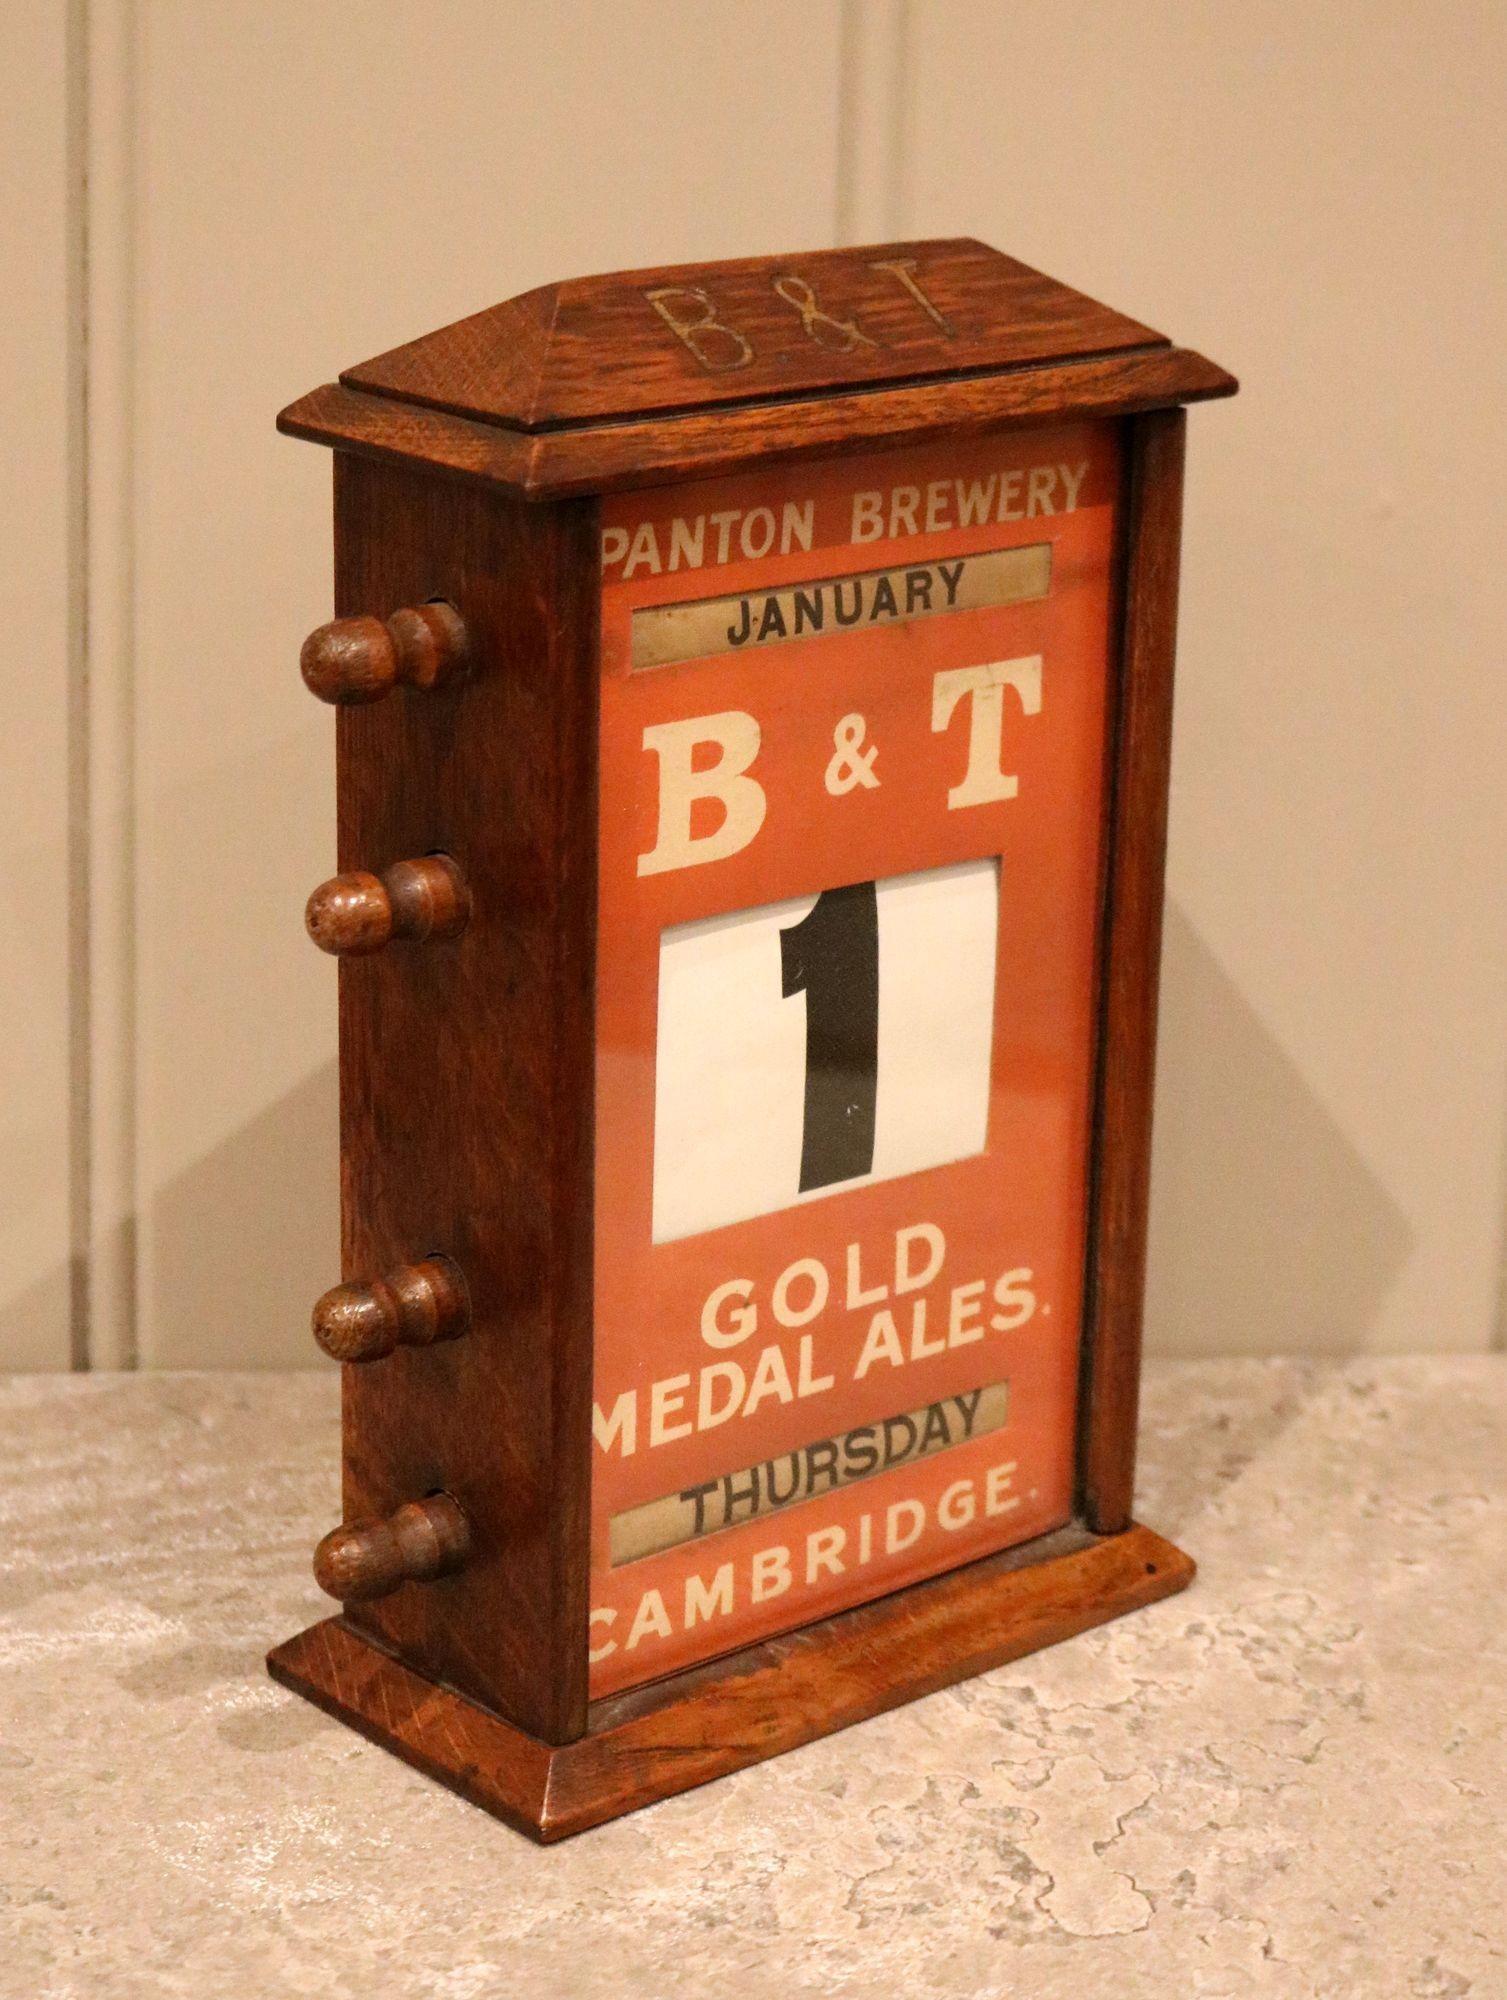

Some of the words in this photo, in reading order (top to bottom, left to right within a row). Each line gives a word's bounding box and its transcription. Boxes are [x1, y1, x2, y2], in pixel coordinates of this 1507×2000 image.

[644, 285, 753, 373] B
[772, 274, 882, 354] &
[866, 257, 957, 338] T
[600, 501, 816, 581] PANTON
[849, 461, 1091, 546] BREWERY
[726, 560, 967, 647] JANUARY
[635, 709, 768, 879] B
[823, 711, 883, 797] &
[930, 653, 1044, 812] T
[779, 882, 879, 1195] 1
[700, 1221, 947, 1350] GOLD
[592, 1333, 835, 1459] MEDAL
[852, 1265, 1052, 1381] ALES.
[679, 1387, 983, 1536] THURSDAY
